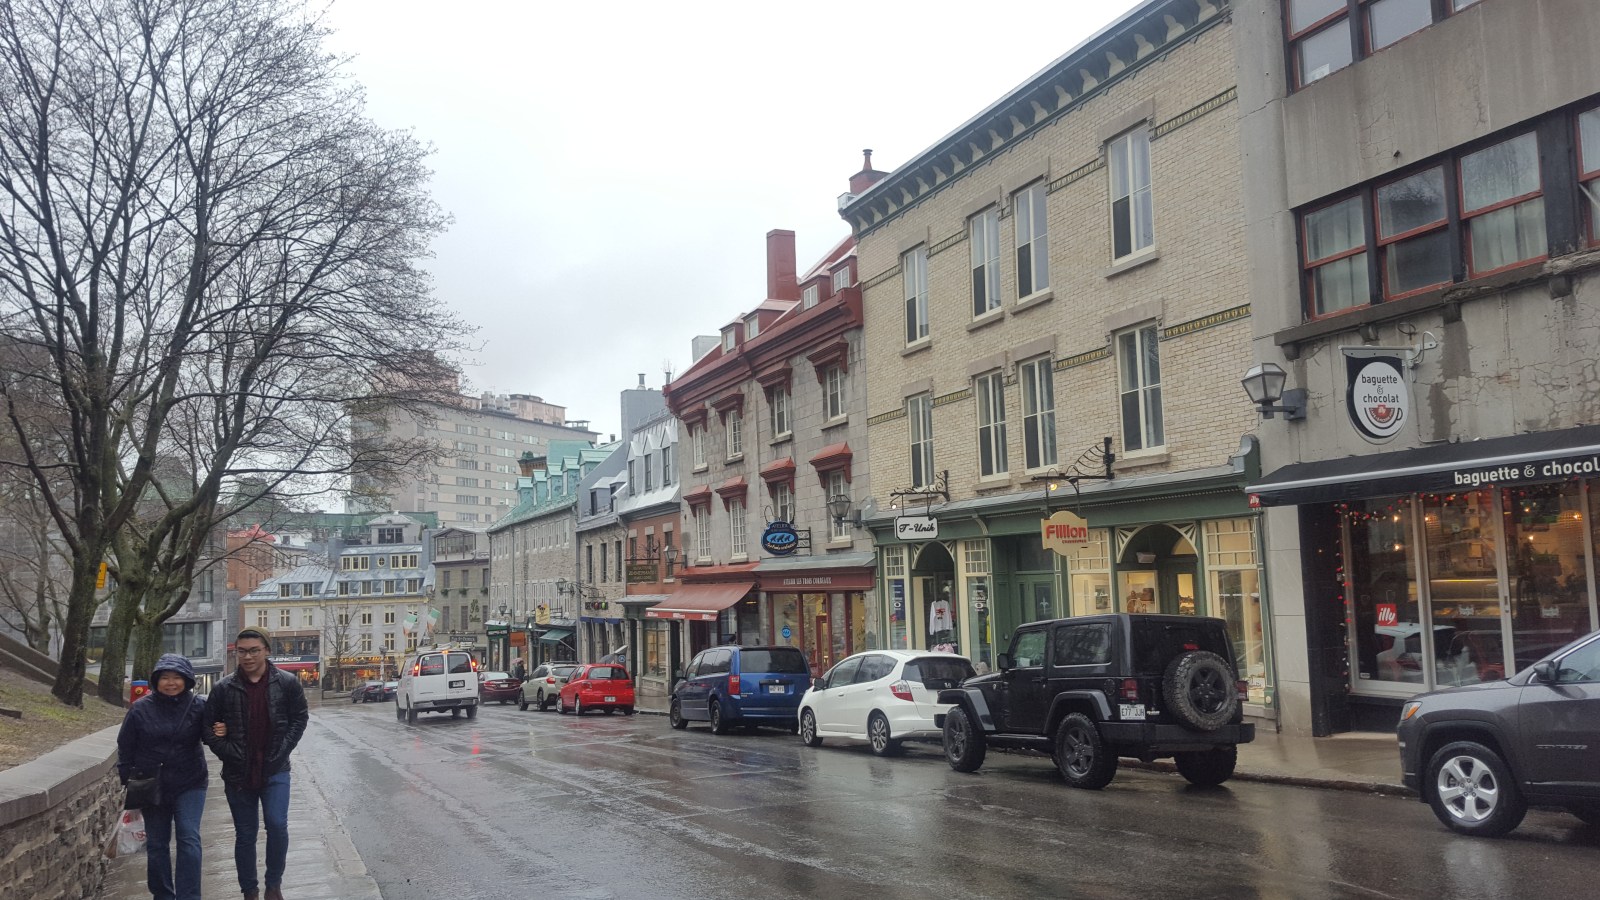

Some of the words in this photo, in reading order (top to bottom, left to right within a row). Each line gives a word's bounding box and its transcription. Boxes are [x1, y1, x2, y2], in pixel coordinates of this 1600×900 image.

[1361, 374, 1398, 386] baguette
[1376, 385, 1384, 395] &
[1362, 393, 1399, 403] chocolat
[1454, 465, 1519, 486] baguette
[1523, 464, 1536, 478] &
[1543, 457, 1600, 476] chocol
[898, 523, 936, 533] T-Unik
[1378, 607, 1396, 625] illy
